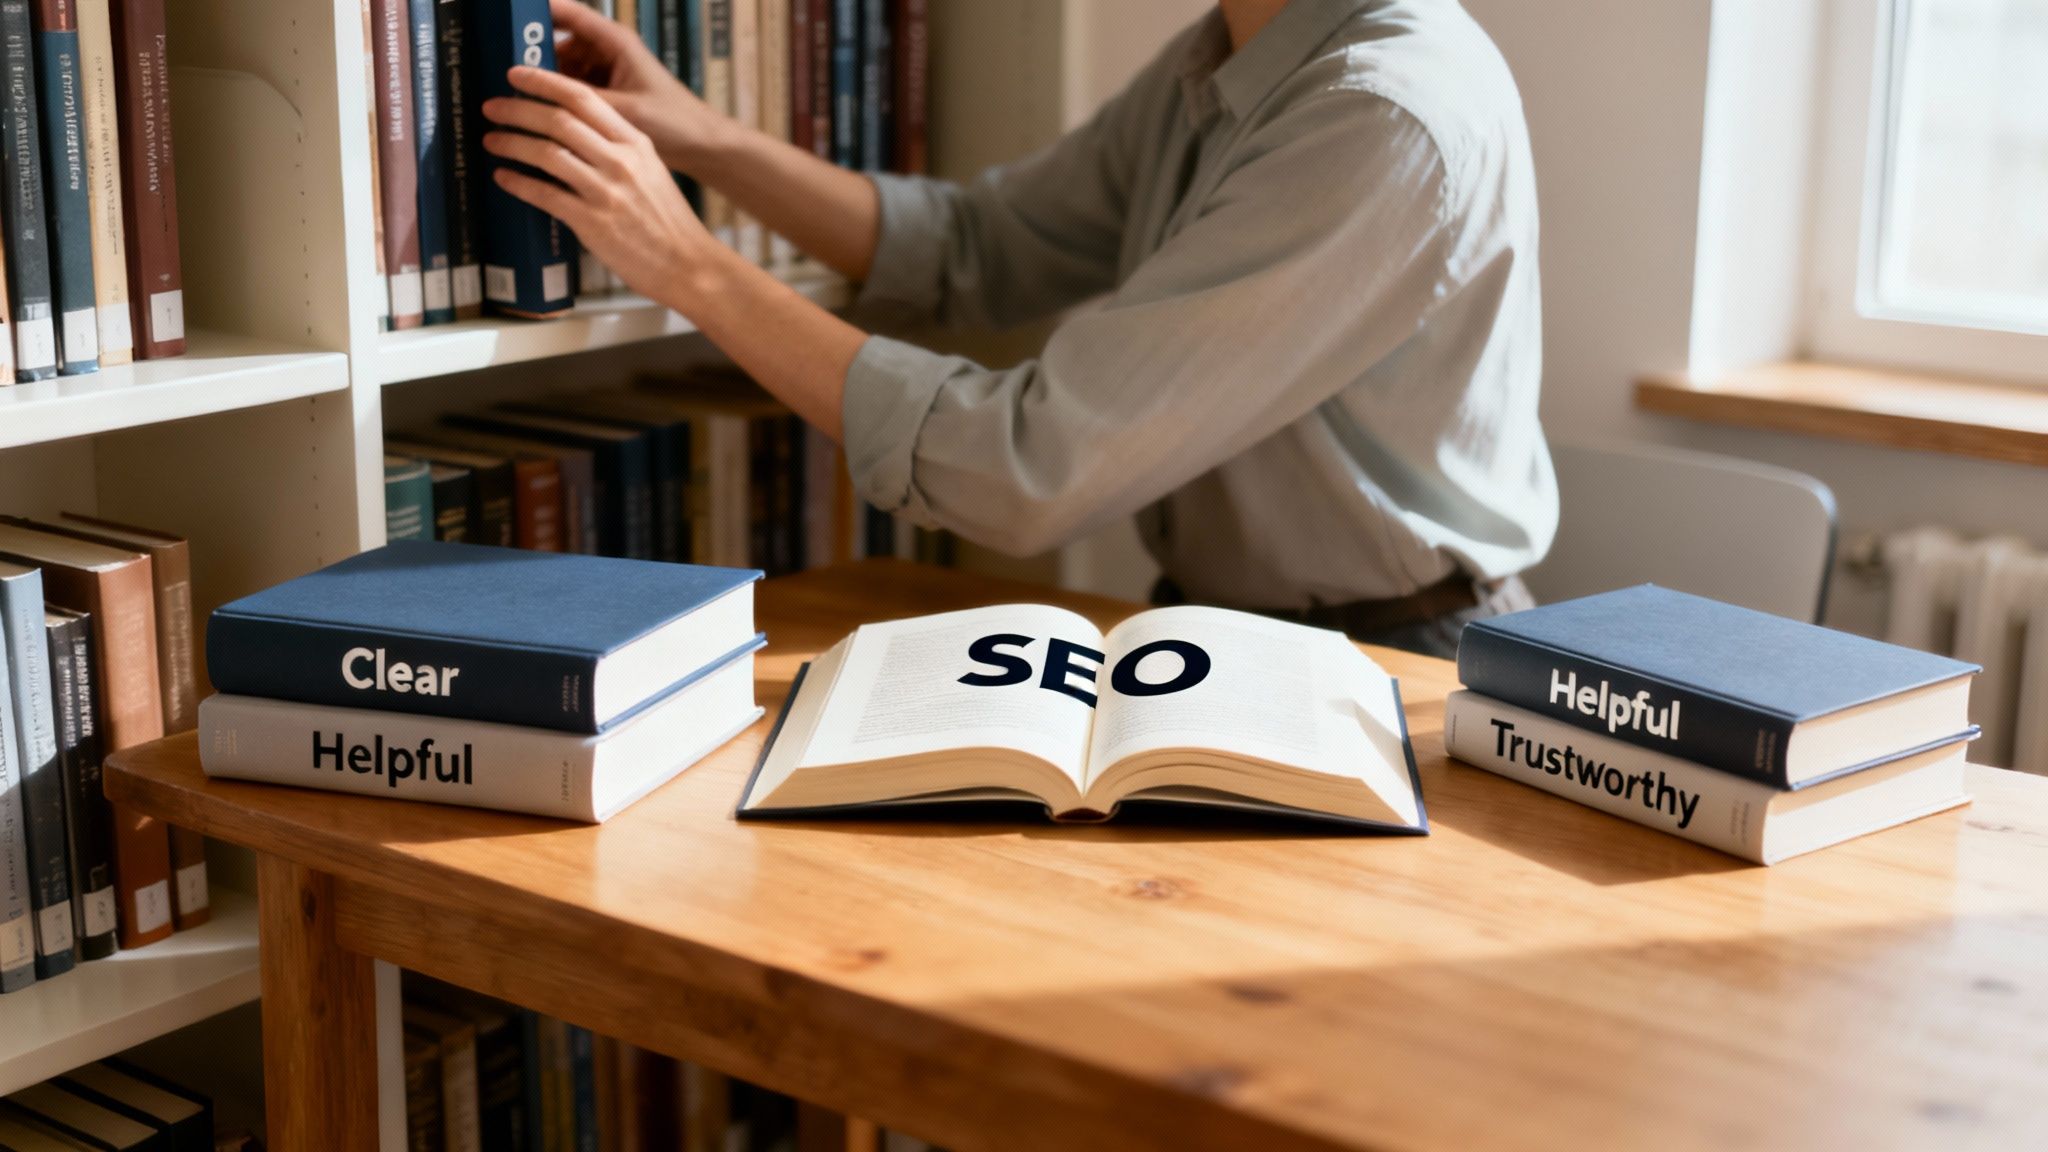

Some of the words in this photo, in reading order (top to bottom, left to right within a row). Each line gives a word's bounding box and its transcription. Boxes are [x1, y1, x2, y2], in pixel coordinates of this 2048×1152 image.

[341, 646, 461, 698] Clear
[957, 633, 1212, 711] SEO
[1549, 667, 1682, 741] Helpful
[311, 730, 474, 789] Helpful
[1490, 718, 1701, 831] Trustworthy
